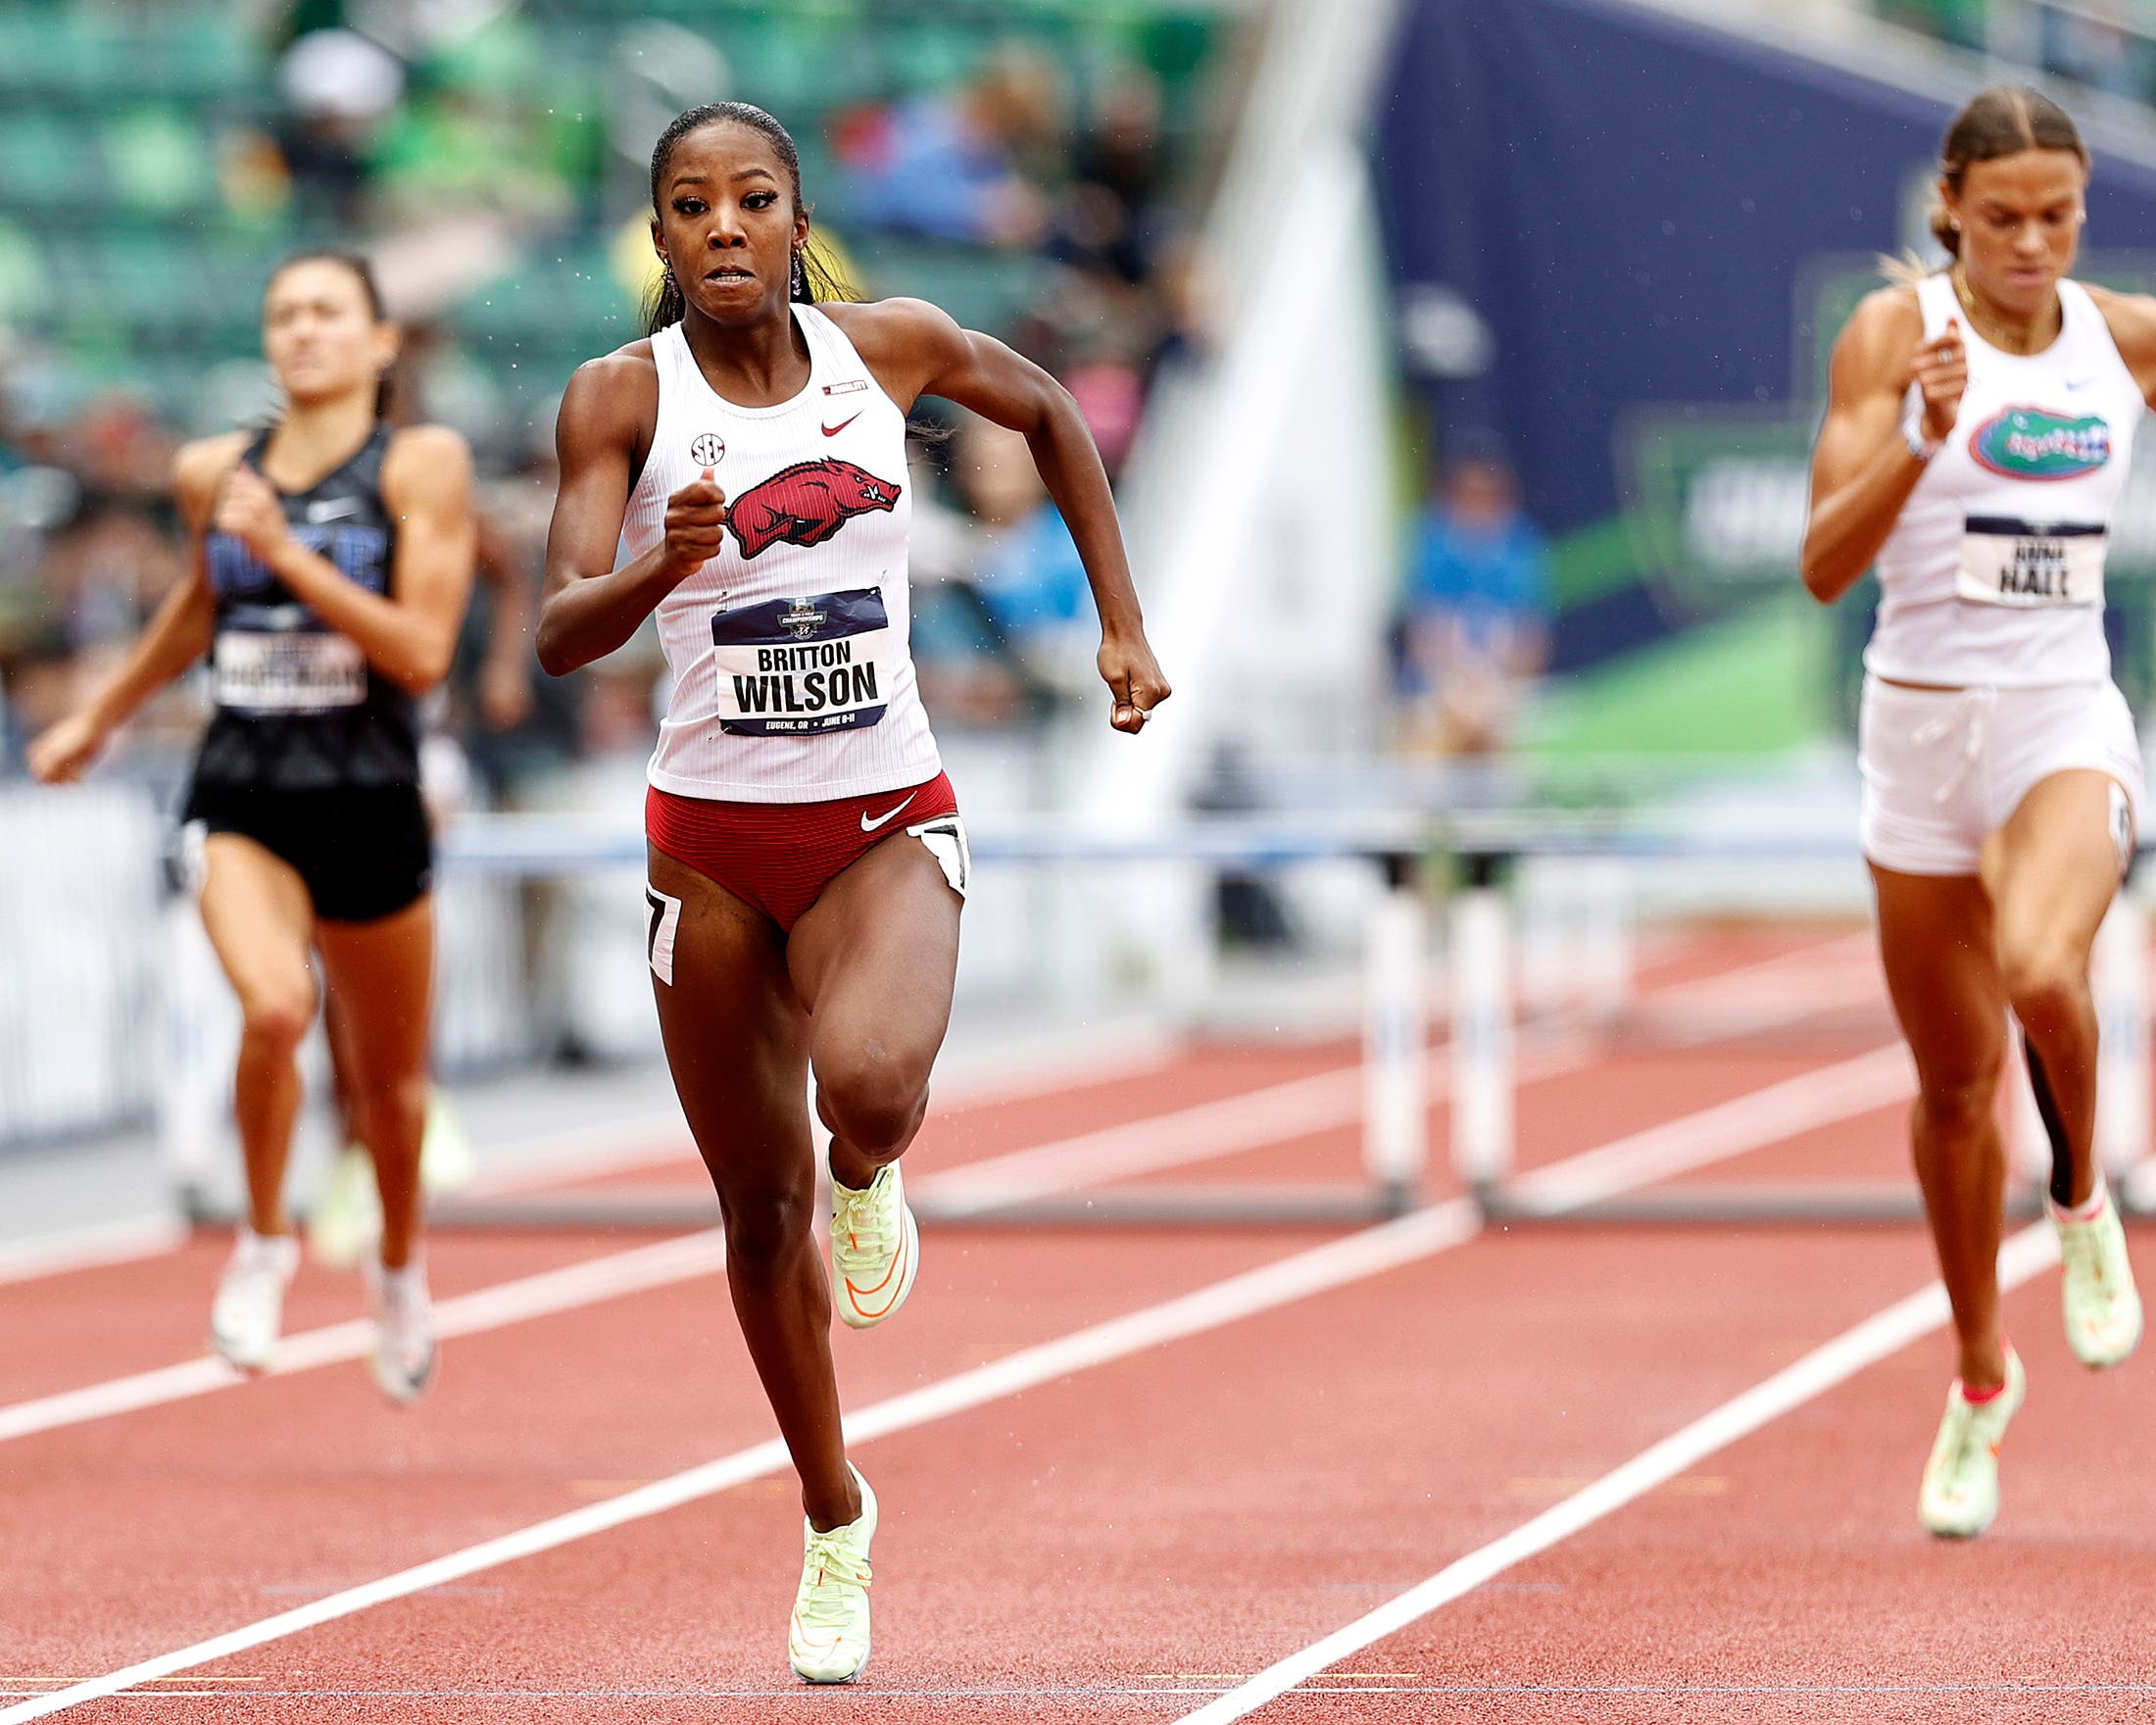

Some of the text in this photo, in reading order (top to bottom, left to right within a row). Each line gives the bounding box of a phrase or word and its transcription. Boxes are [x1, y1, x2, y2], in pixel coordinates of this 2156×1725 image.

[692, 433, 724, 466] SEC
[2000, 566, 2068, 595] HALL
[758, 640, 851, 672] BRITTON
[733, 662, 878, 714] WILSON
[765, 720, 796, 730] EUGENE,
[821, 715, 841, 727] JUNE
[842, 713, 856, 724] 8-11
[645, 884, 666, 963] 7
